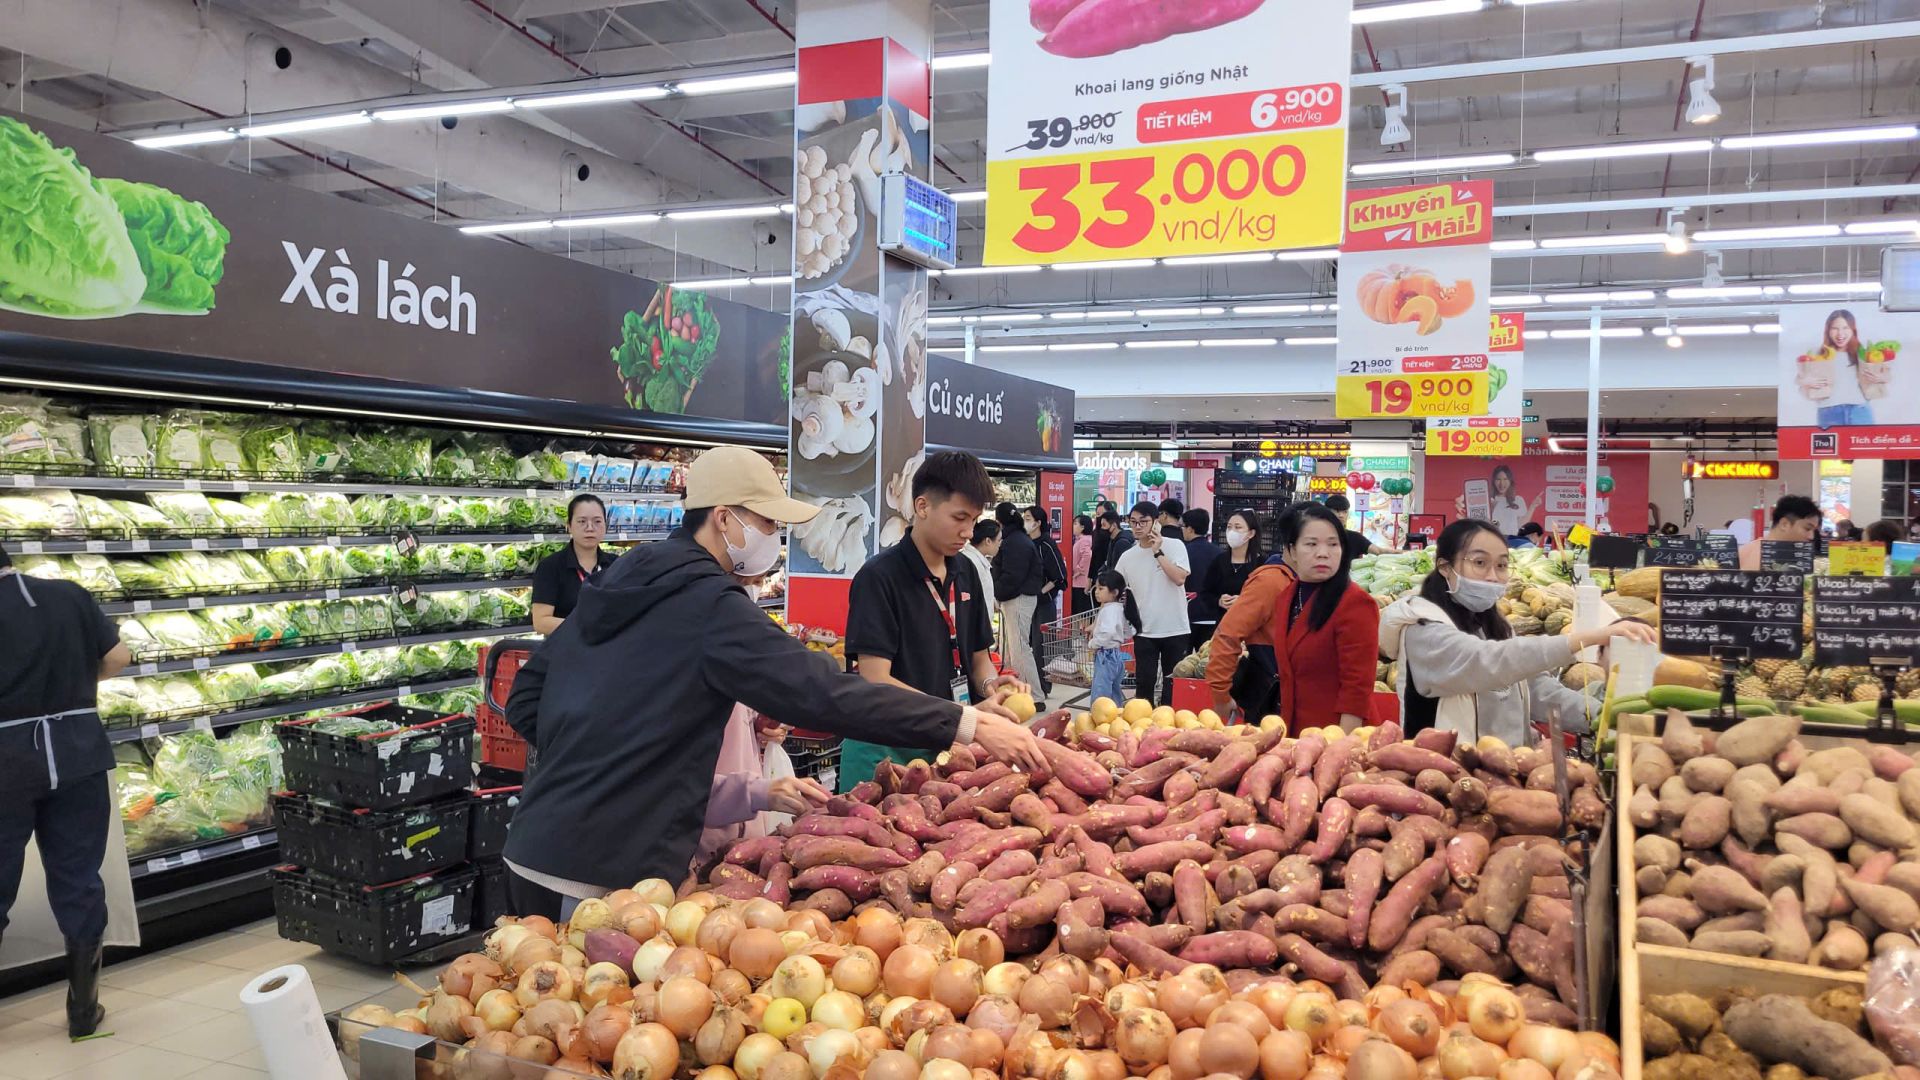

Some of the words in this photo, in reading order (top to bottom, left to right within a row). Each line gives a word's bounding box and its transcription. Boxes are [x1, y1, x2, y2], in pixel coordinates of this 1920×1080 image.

[1074, 82, 1117, 97] Khoai
[1122, 77, 1155, 92] lang
[1159, 70, 1205, 91] giống
[1210, 65, 1249, 83] Nhật
[1144, 110, 1175, 131] TIẾT
[1177, 107, 1213, 130] KIỆM
[1281, 109, 1322, 125] vnd/kg
[1074, 131, 1114, 147] vnd/kg
[1353, 192, 1446, 225] Khuyến
[1163, 206, 1276, 245] vnd/kg
[279, 240, 360, 315] Xà
[376, 258, 477, 335] lách
[929, 378, 951, 416] Củ
[955, 393, 974, 420] sơ
[977, 390, 1004, 424] chế
[1420, 400, 1470, 413] vnd/kg
[1850, 436, 1870, 444] Tích
[1076, 450, 1147, 470] Ladofoods
